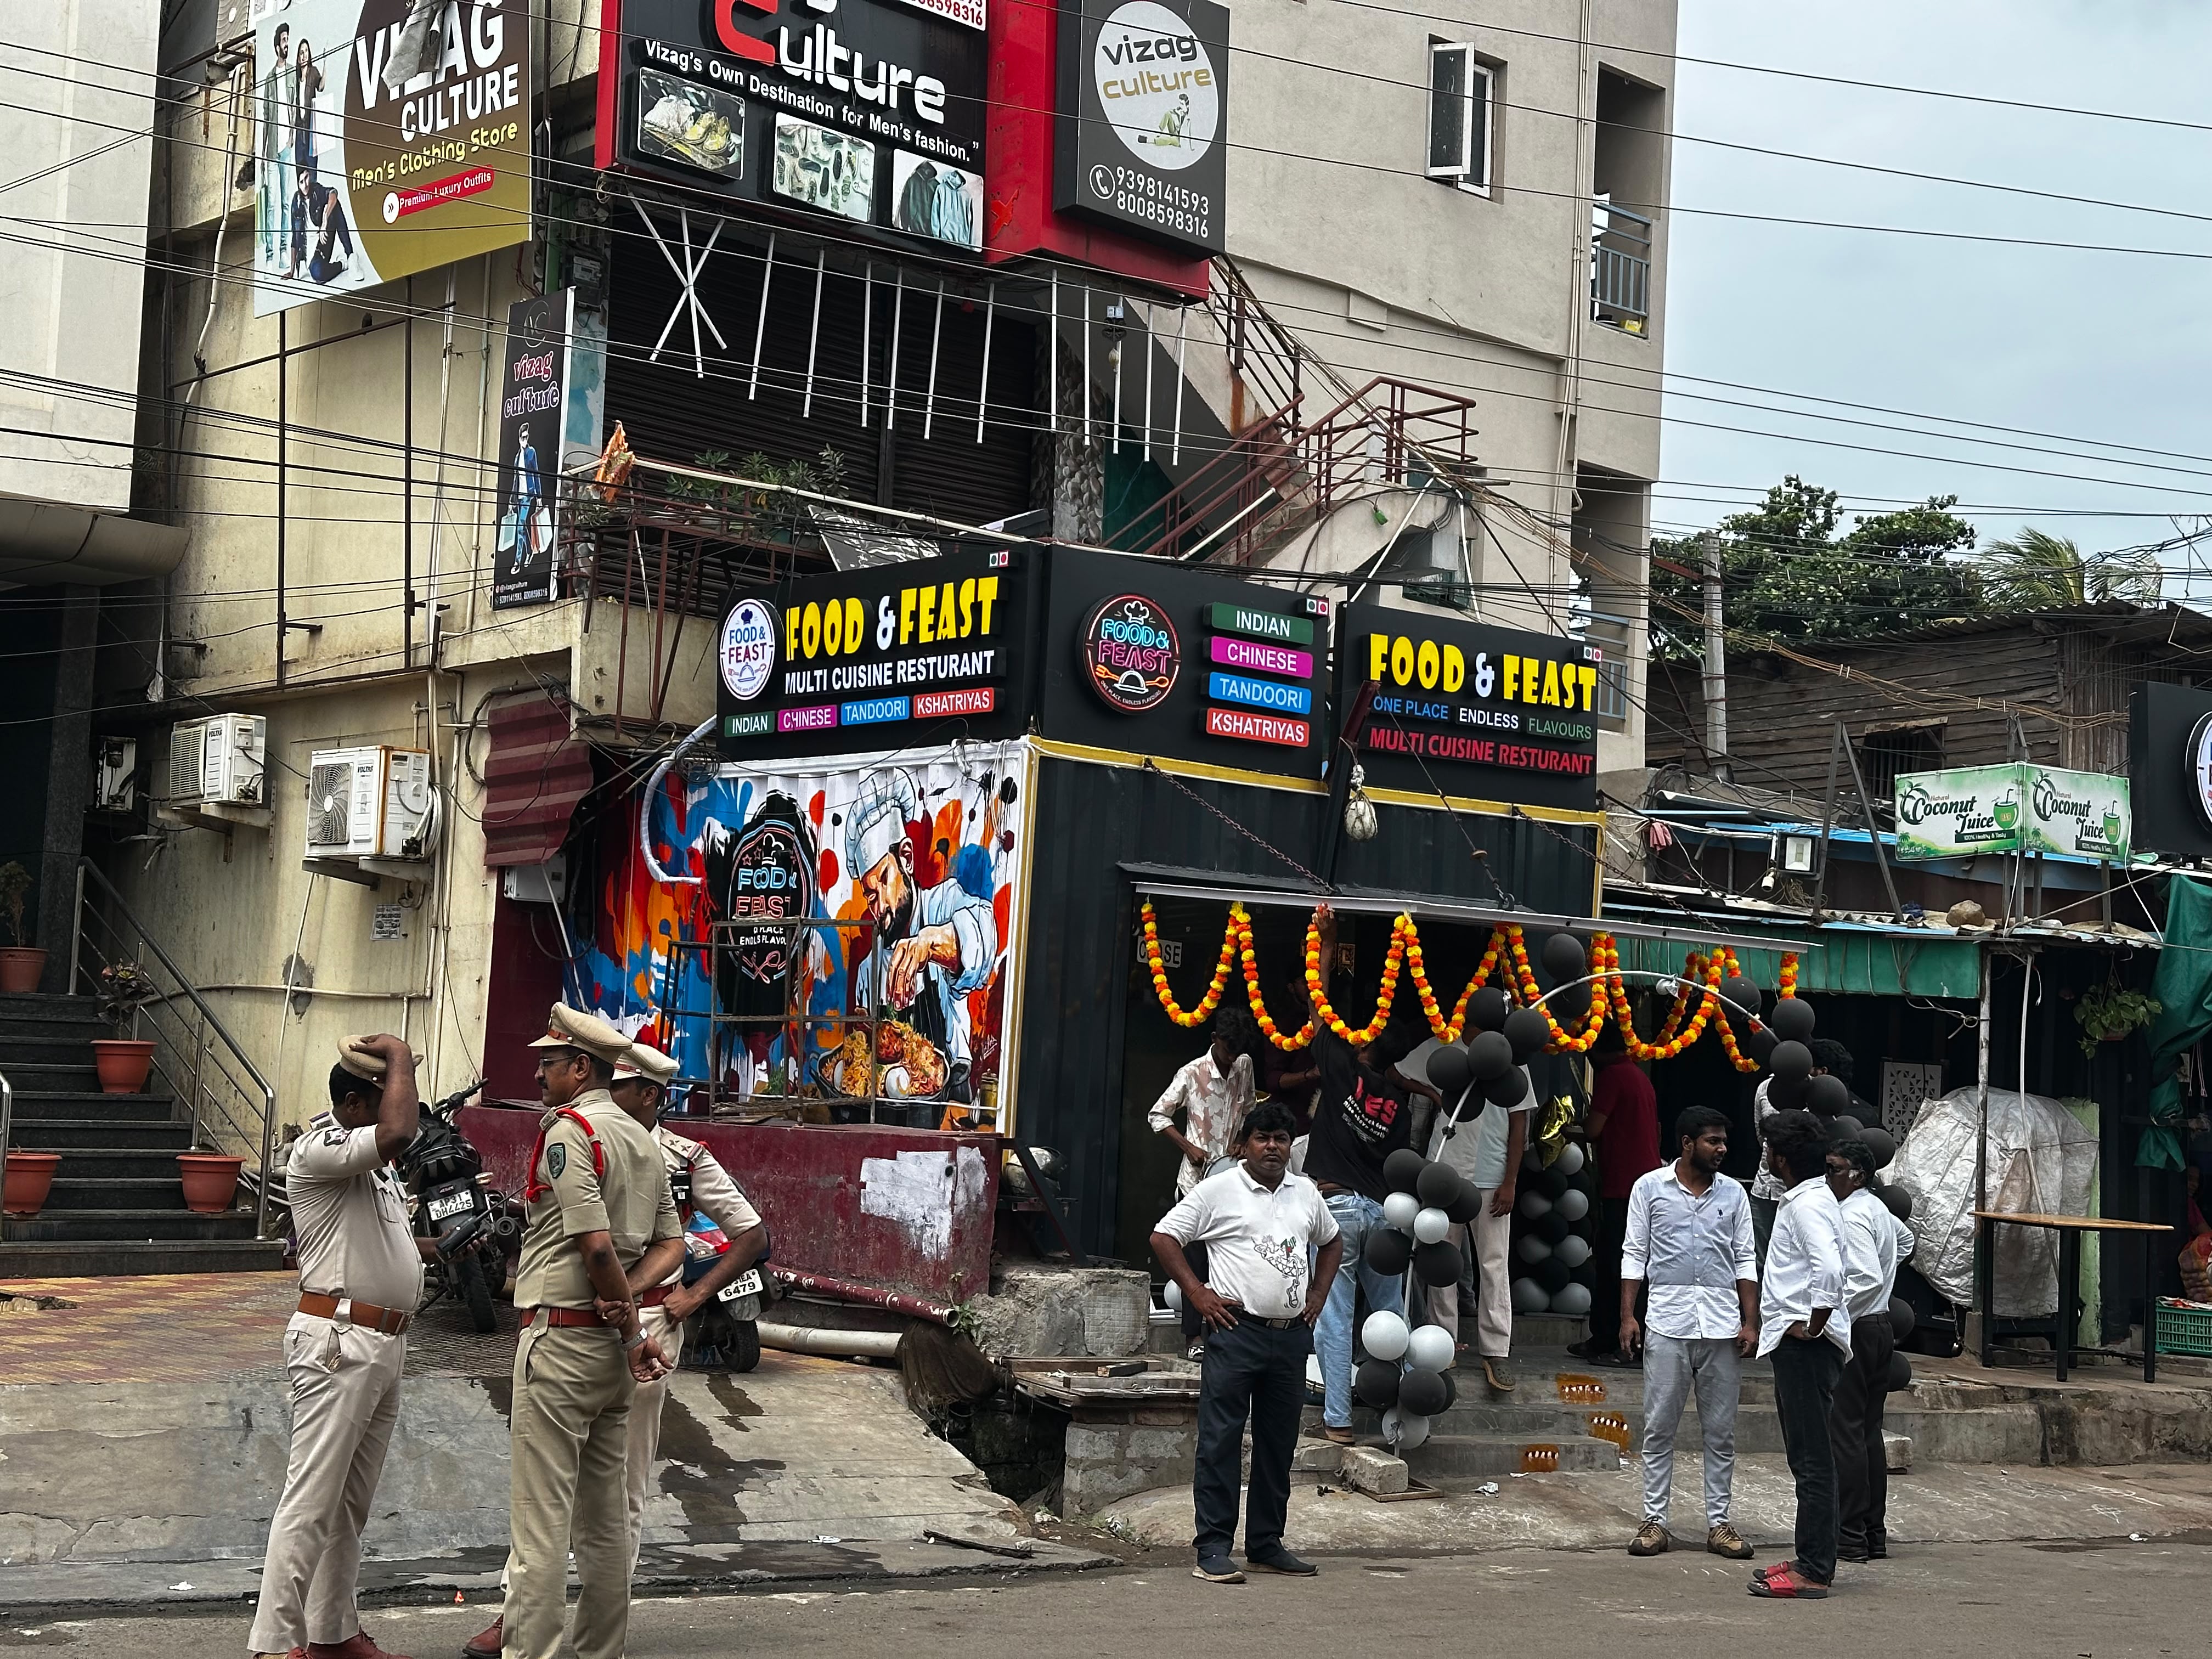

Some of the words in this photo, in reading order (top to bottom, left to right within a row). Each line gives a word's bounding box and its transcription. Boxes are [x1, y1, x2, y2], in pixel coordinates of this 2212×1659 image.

[356, 0, 504, 110] VIAG
[715, 0, 945, 124] Culture
[1102, 35, 1198, 65] vizag
[645, 39, 703, 74] Vizag's
[709, 60, 744, 86] Own
[749, 77, 834, 119] Destination
[842, 106, 863, 127] for
[870, 115, 911, 144] Men's
[1103, 67, 1211, 99] culture
[401, 63, 519, 142] CULTURE
[400, 140, 466, 176] Clothing
[471, 121, 518, 154] Store
[399, 190, 433, 210] Premium
[434, 183, 462, 199] Luxury
[464, 171, 492, 190] Outfits
[1116, 166, 1209, 215] 9398141593
[1116, 190, 1209, 238] 8008598316
[504, 381, 560, 418] culture
[786, 597, 865, 662] FOOD
[876, 595, 896, 651] &
[900, 576, 998, 645] FEAST
[1101, 618, 1155, 647] FOOD
[1155, 630, 1170, 650] &
[1236, 610, 1290, 637] INDIAN
[729, 626, 757, 645] FOOD
[759, 626, 766, 640] &
[729, 642, 767, 665] FEAST
[1098, 640, 1171, 674] FEAST
[1227, 643, 1297, 672] CHINESE
[785, 666, 828, 695] MULTI
[832, 661, 893, 690] CUISINE
[897, 650, 995, 684] RESTURANT
[1370, 633, 1465, 692] FOOD
[1475, 652, 1495, 697] &
[1503, 654, 1596, 712] FEAST
[1220, 678, 1302, 709] TANDOORI
[732, 715, 768, 734] INDIAN
[783, 708, 832, 729] CHINESE
[845, 699, 906, 721] TANDOORI
[917, 691, 990, 715] KSHATRIYAS
[1212, 712, 1305, 742] KSHATRIYAS
[1373, 695, 1402, 713] ONE
[1406, 700, 1448, 720] PLACE
[1459, 707, 1519, 729] ENDLESS
[1528, 718, 1592, 740] FLAVOURS
[1369, 727, 1424, 754] MULTI
[1428, 735, 1494, 761] CUISINE
[1498, 744, 1593, 775] RESTURANT
[1912, 796, 1977, 824] Coconut
[2042, 791, 2091, 820] Coconut
[1955, 813, 1994, 834] Juice
[2075, 817, 2103, 839] Juice
[1139, 940, 1181, 964] CSE
[435, 1199, 472, 1219] DH4425
[439, 1194, 462, 1209] AP31
[724, 1282, 756, 1297] 6479
